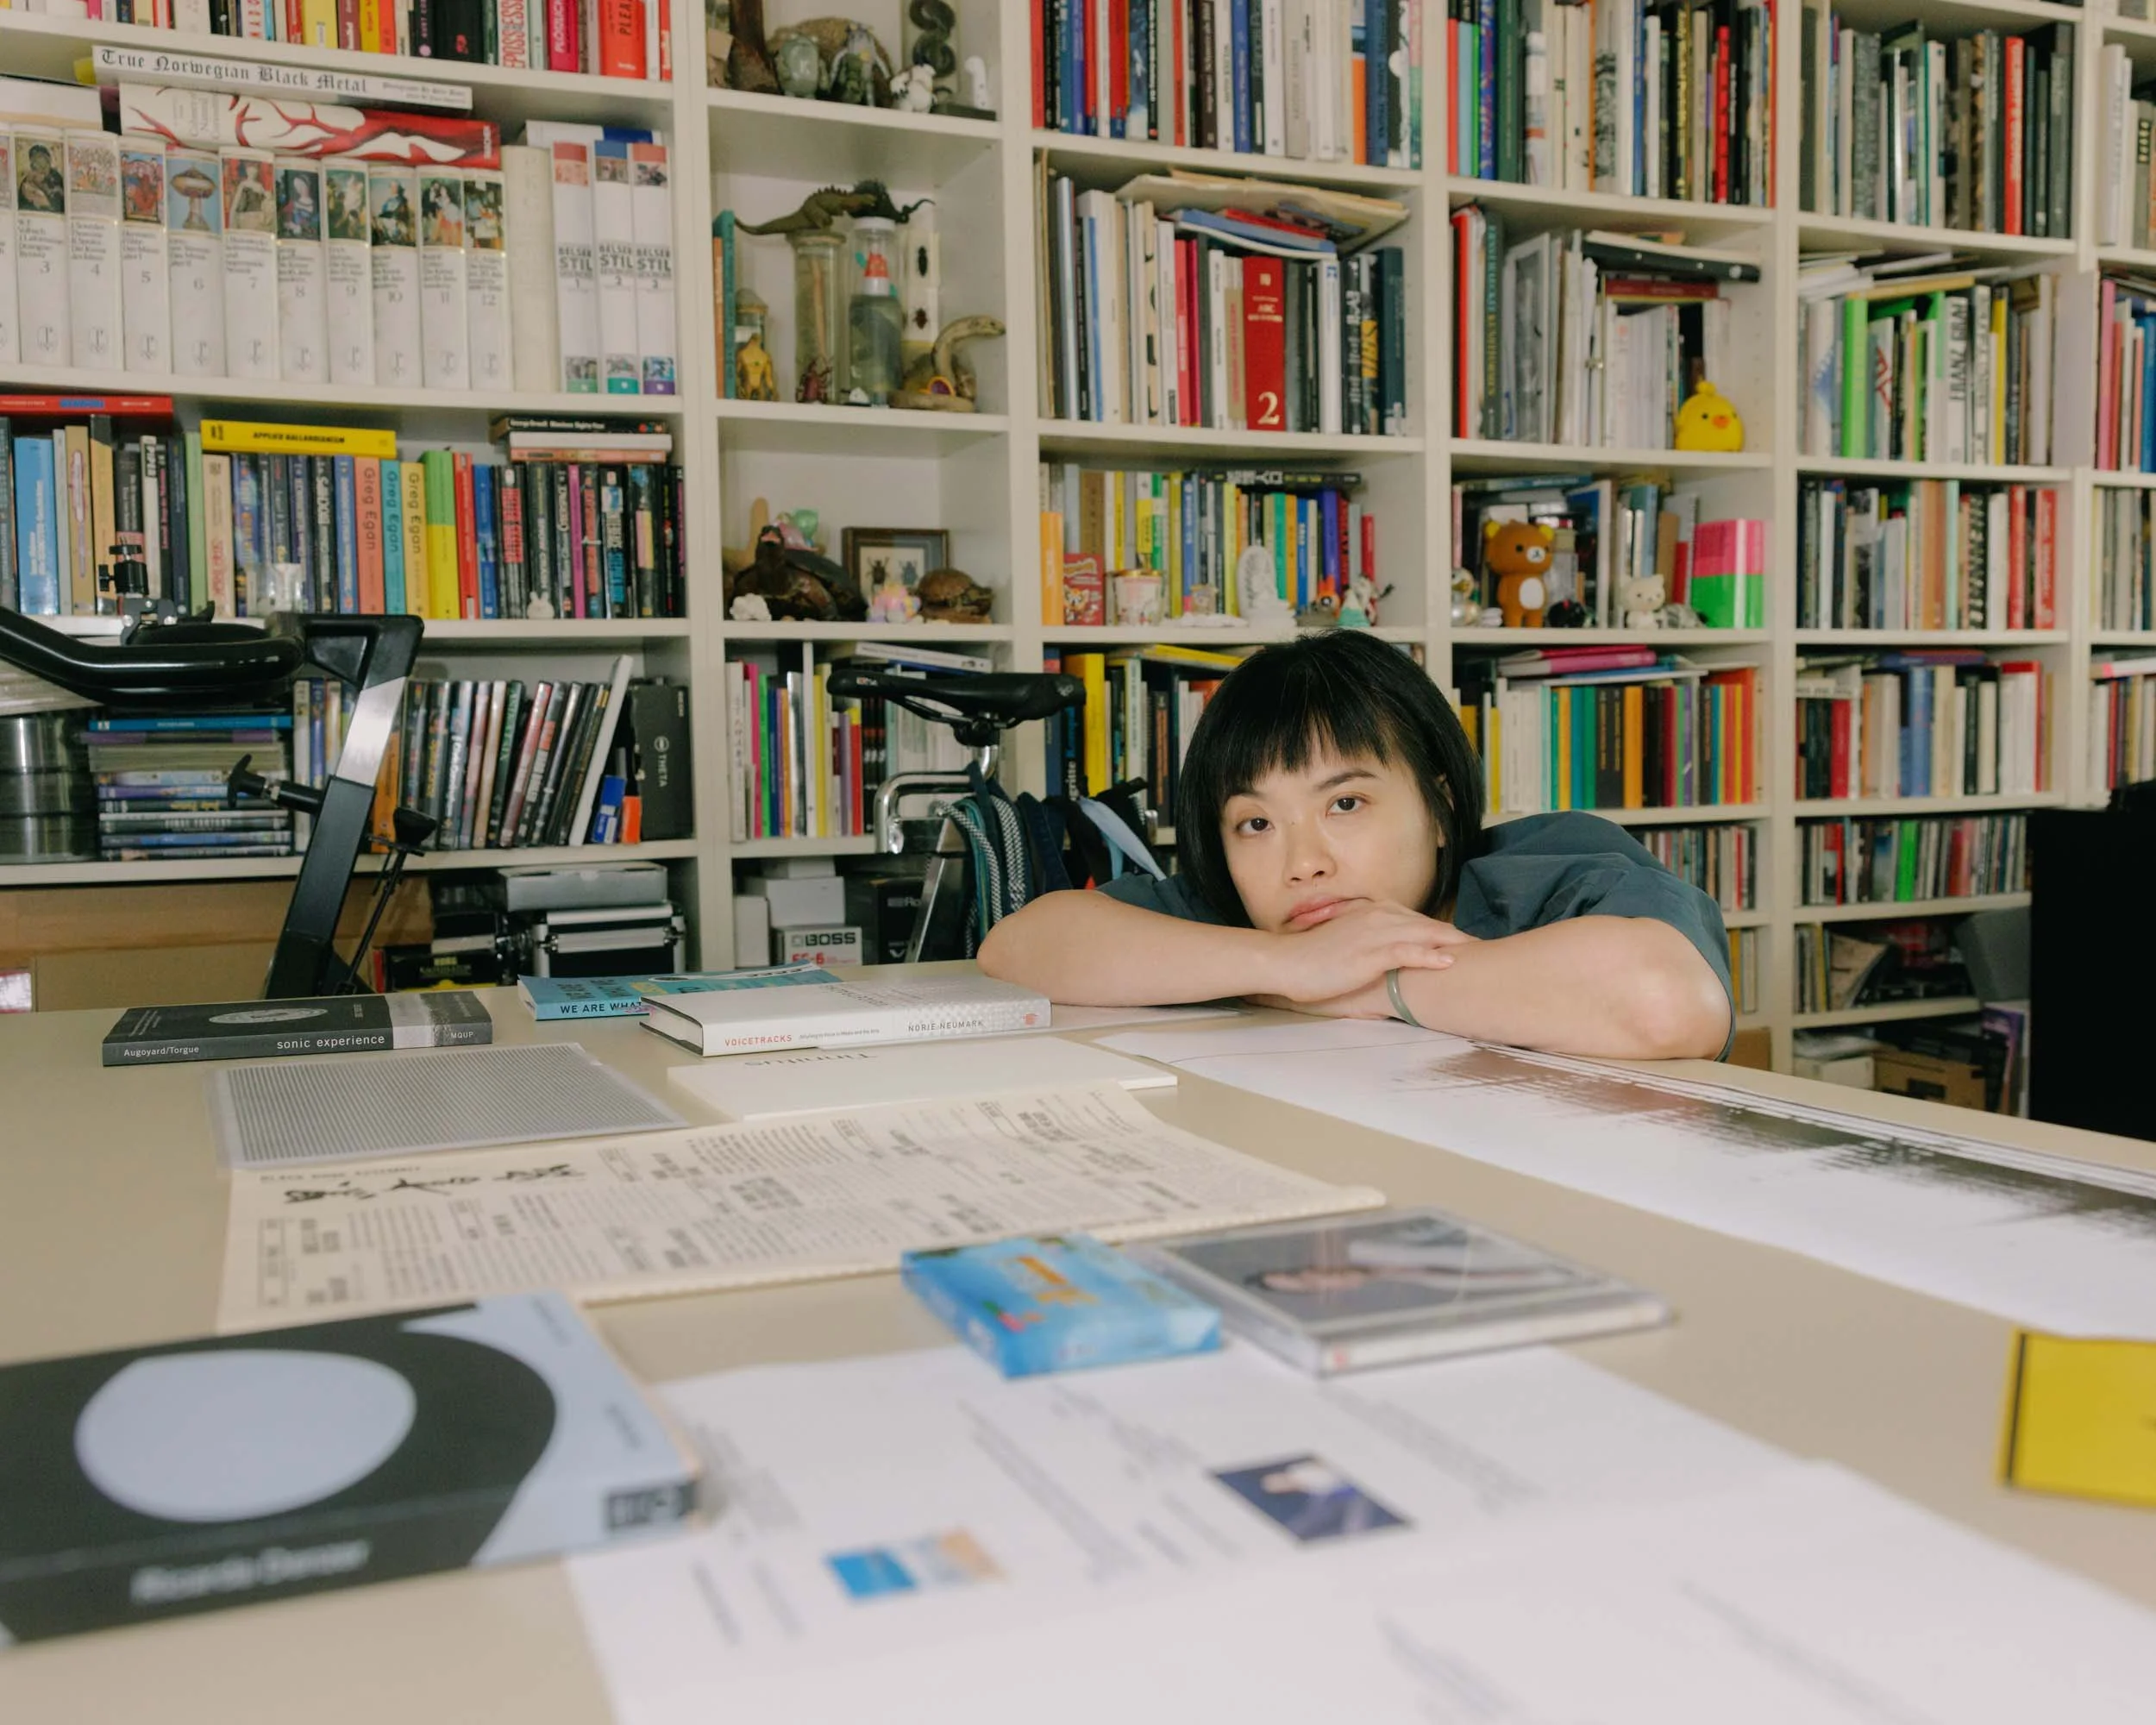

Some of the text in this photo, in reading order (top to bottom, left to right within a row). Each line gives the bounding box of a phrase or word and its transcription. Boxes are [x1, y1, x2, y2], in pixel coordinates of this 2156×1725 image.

[102, 48, 145, 68] True
[153, 55, 249, 79] Norwegian
[258, 66, 309, 86] Black
[317, 77, 367, 92] Metal
[41, 262, 50, 274] 3
[559, 257, 593, 271] STIL
[599, 256, 634, 270] STIL
[637, 259, 672, 272] STIL
[91, 264, 101, 276] 4
[141, 271, 150, 284] 5
[249, 277, 259, 289] 7
[194, 279, 204, 291] 6
[295, 285, 305, 298] 8
[347, 285, 356, 298] 9
[388, 292, 403, 304] 10
[440, 292, 450, 304] 11
[481, 293, 496, 306] 12
[1950, 348, 1966, 400] FRANZ
[1257, 392, 1280, 424] 2
[364, 468, 377, 550] Greg Egan
[386, 472, 398, 553] Greg Egan
[409, 473, 421, 555] Greg Egan
[658, 755, 667, 787] THETA
[805, 932, 856, 946] BOSS
[561, 1005, 579, 1014] WE
[583, 1003, 605, 1013] ARE
[908, 1020, 982, 1032] NORIE NEUMARK
[123, 1033, 385, 1057] Augoyard/Torgue sonic experience
[724, 1034, 793, 1047] VOICETRACKS
